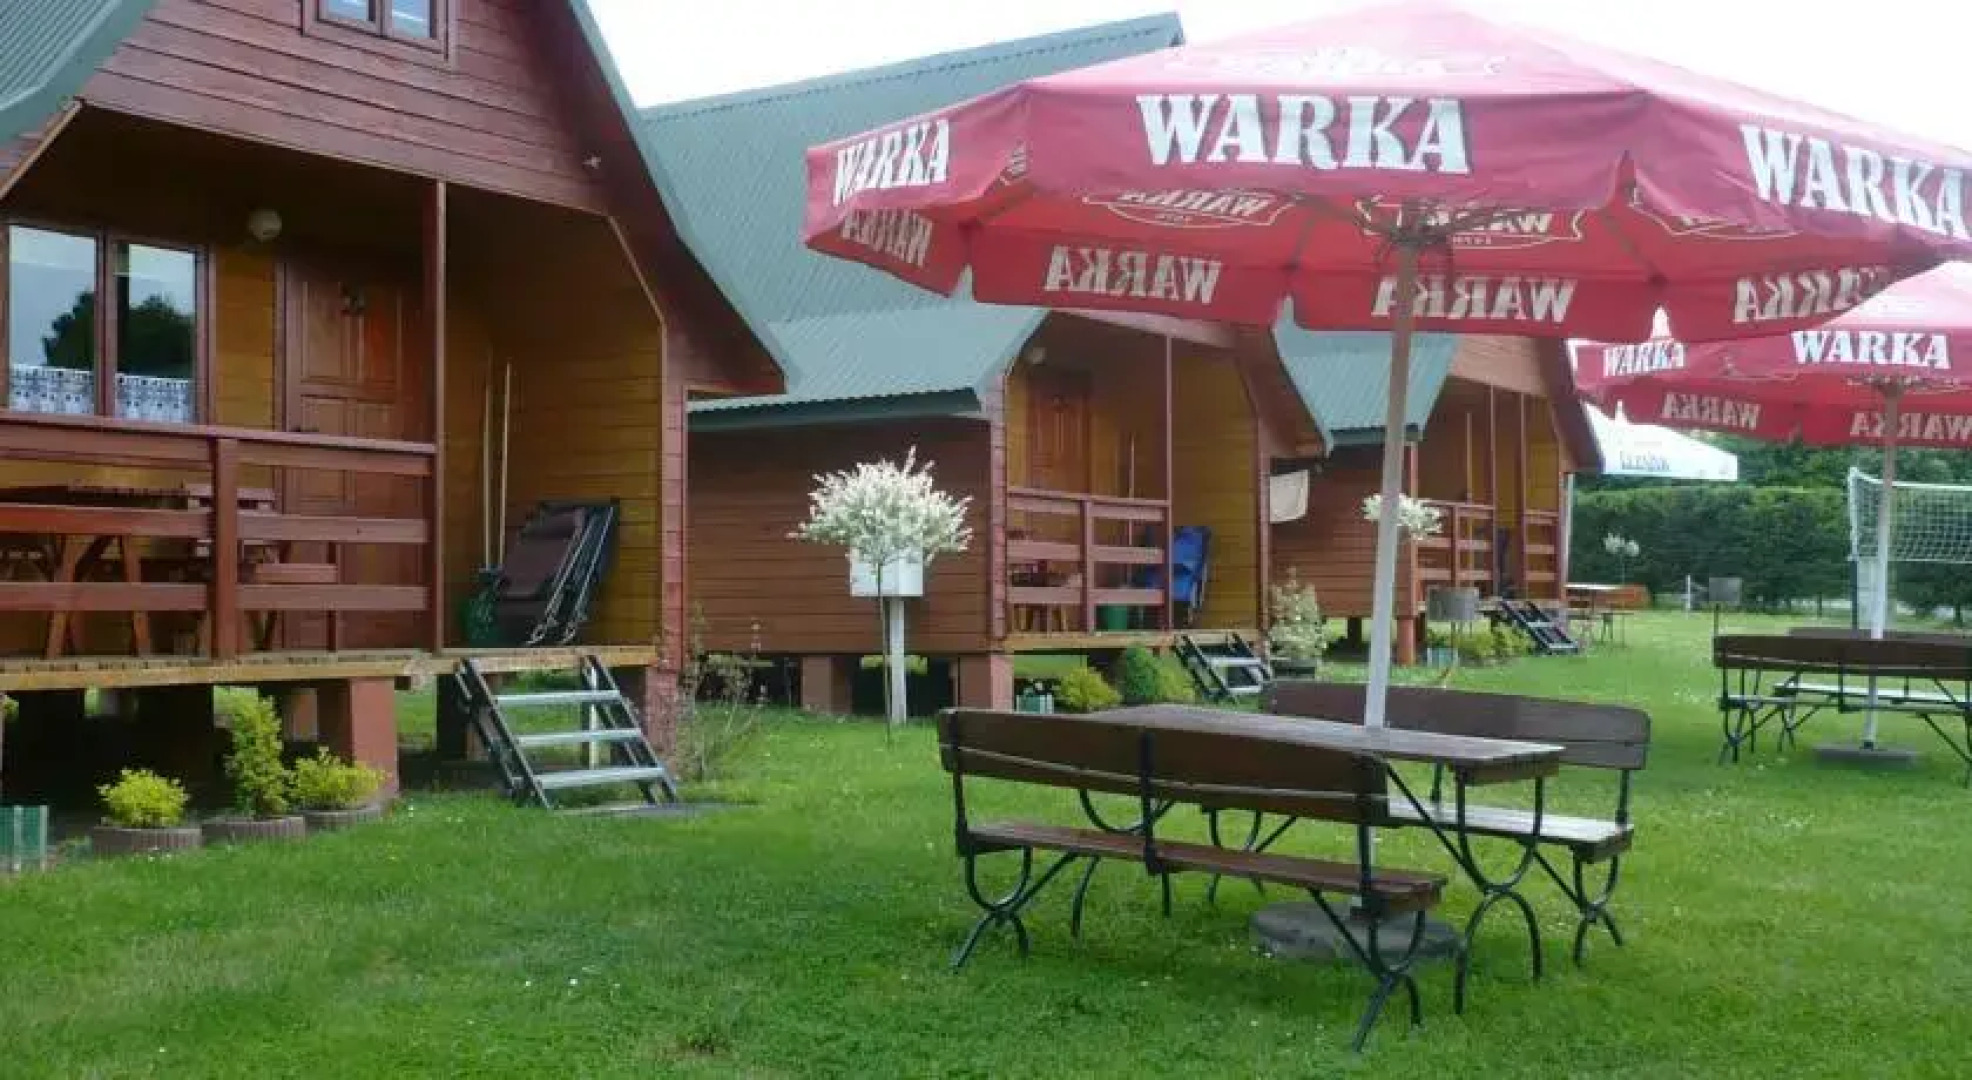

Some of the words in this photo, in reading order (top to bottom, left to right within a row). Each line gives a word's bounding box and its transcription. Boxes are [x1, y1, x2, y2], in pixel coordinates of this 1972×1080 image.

[833, 119, 949, 207] WARKA
[1136, 93, 1470, 175] WARKA
[1739, 123, 1972, 240] WARKA
[1603, 342, 1684, 376] WARKA
[1790, 331, 1950, 369] WARKA
